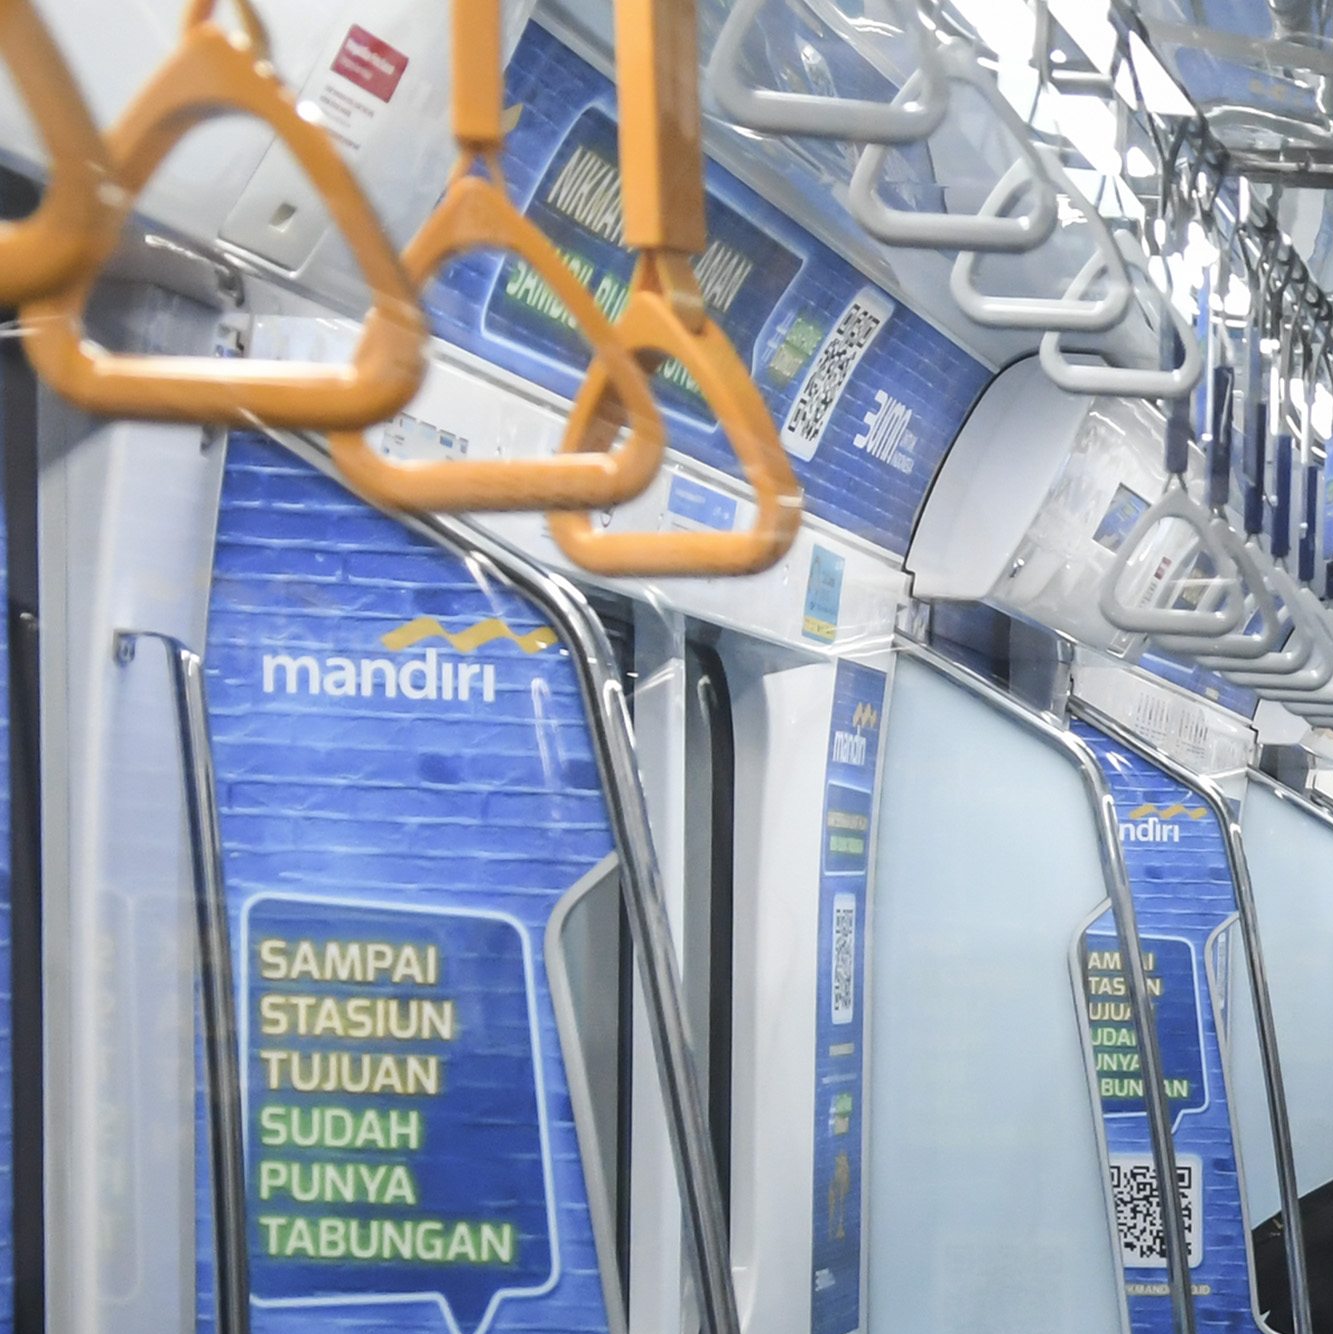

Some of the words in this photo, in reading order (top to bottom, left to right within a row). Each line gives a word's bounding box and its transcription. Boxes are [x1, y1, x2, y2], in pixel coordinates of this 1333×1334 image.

[262, 648, 496, 702] mandiri
[1119, 817, 1179, 842] ndiri
[258, 939, 438, 985] SAMPAI
[258, 995, 455, 1041] STASIUN
[258, 1050, 439, 1095] TUJUAN
[259, 1106, 420, 1150] SUDAH
[259, 1161, 417, 1205] PUNYA
[258, 1216, 514, 1263] TABUNGAN
